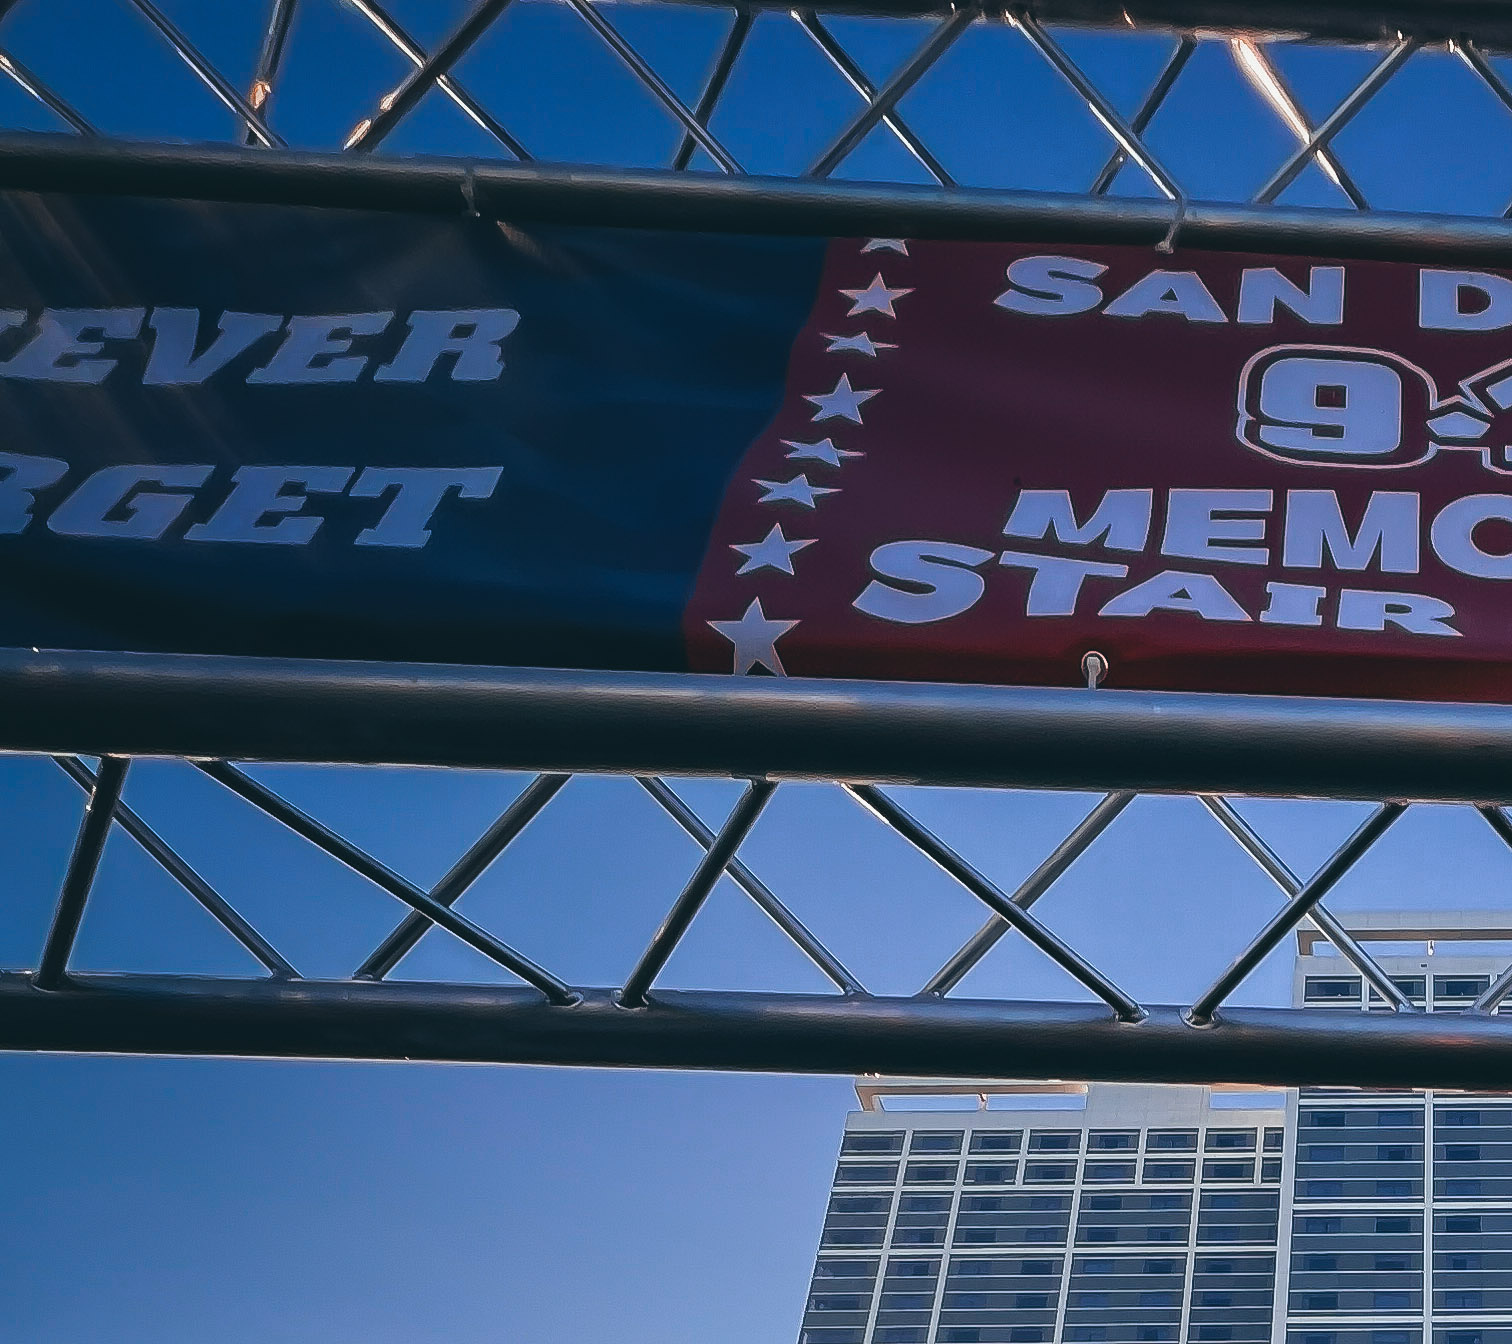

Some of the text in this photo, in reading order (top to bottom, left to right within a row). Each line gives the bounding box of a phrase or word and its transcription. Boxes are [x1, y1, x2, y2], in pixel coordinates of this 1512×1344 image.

[993, 255, 1346, 325] SAN
[0, 307, 521, 385] EVER
[852, 540, 1464, 637] STAIR
